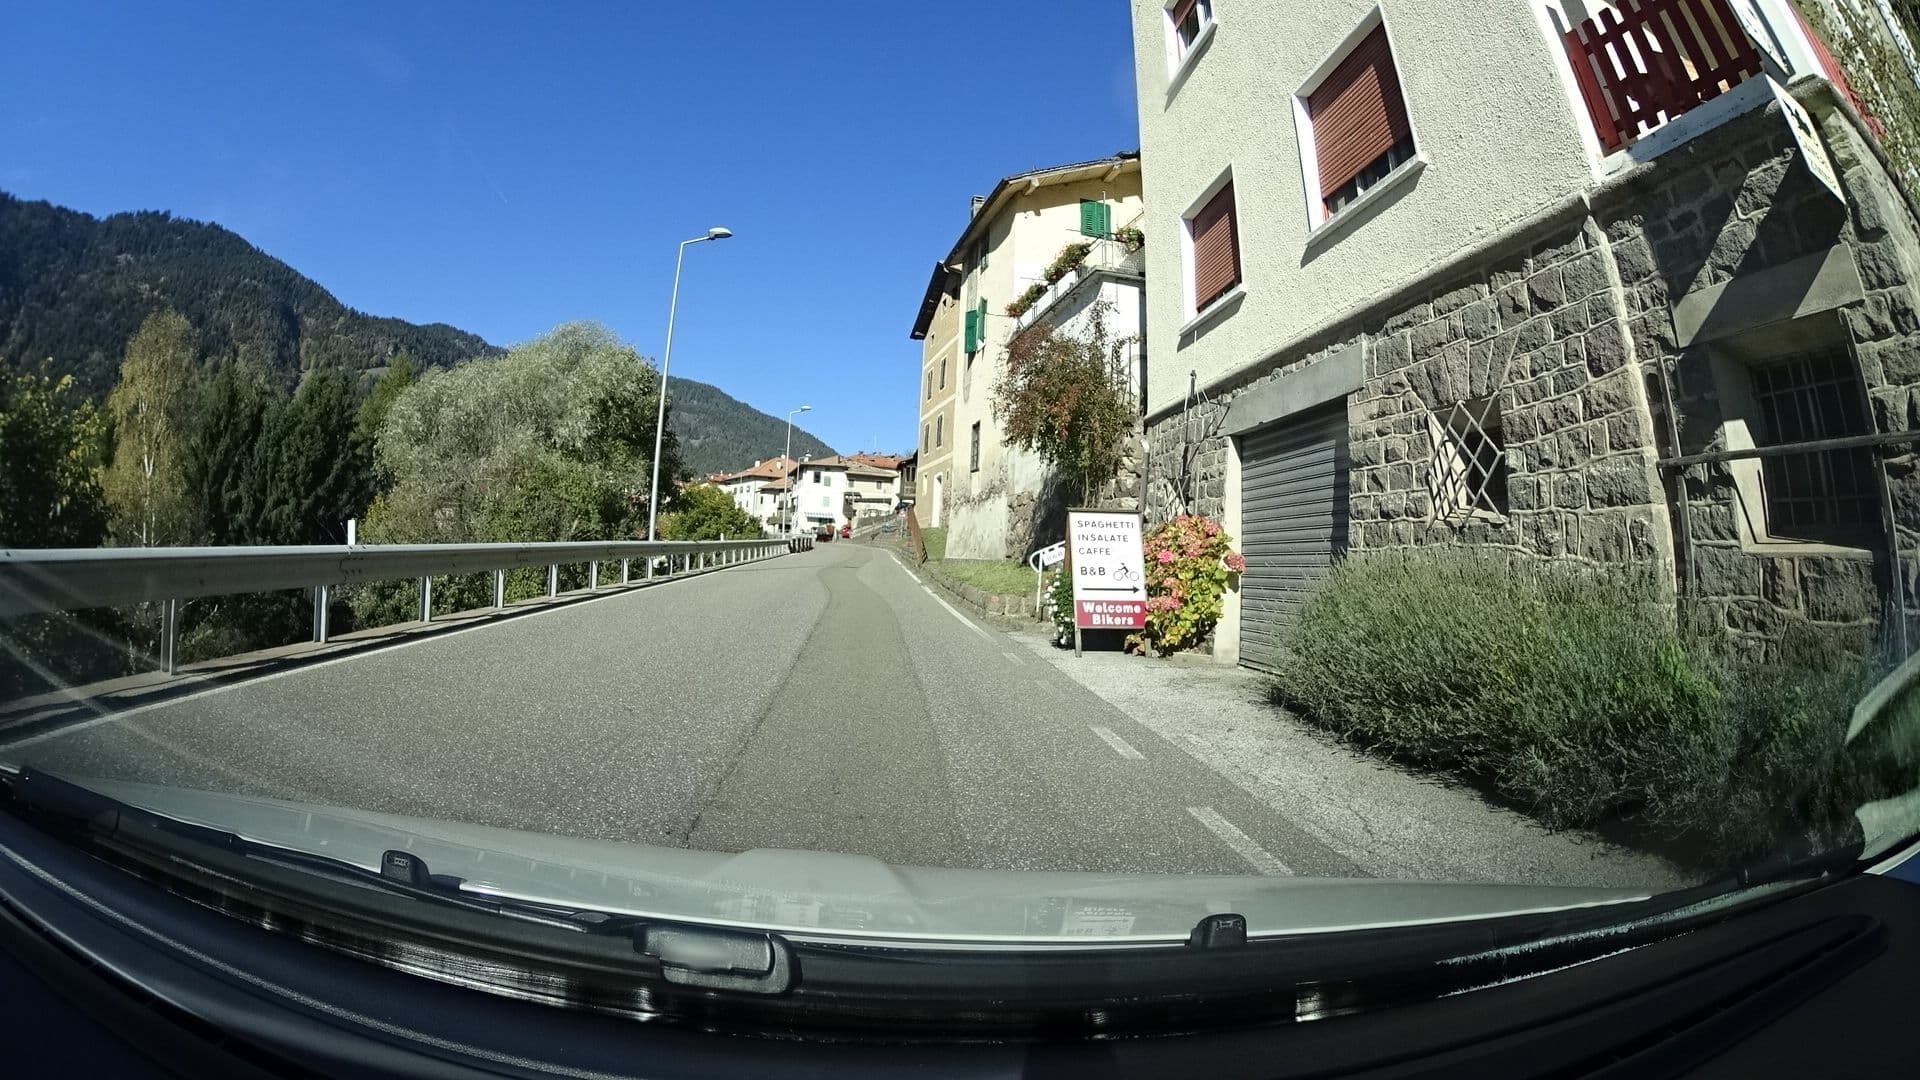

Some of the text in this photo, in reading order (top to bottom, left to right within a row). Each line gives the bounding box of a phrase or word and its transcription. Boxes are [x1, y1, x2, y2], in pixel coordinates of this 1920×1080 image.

[1077, 520, 1134, 528] SPAGHETTI
[1078, 534, 1129, 542] INSALATE
[1080, 566, 1106, 576] B&B
[1082, 602, 1141, 613] Welcome
[1092, 613, 1134, 625] Bikers
